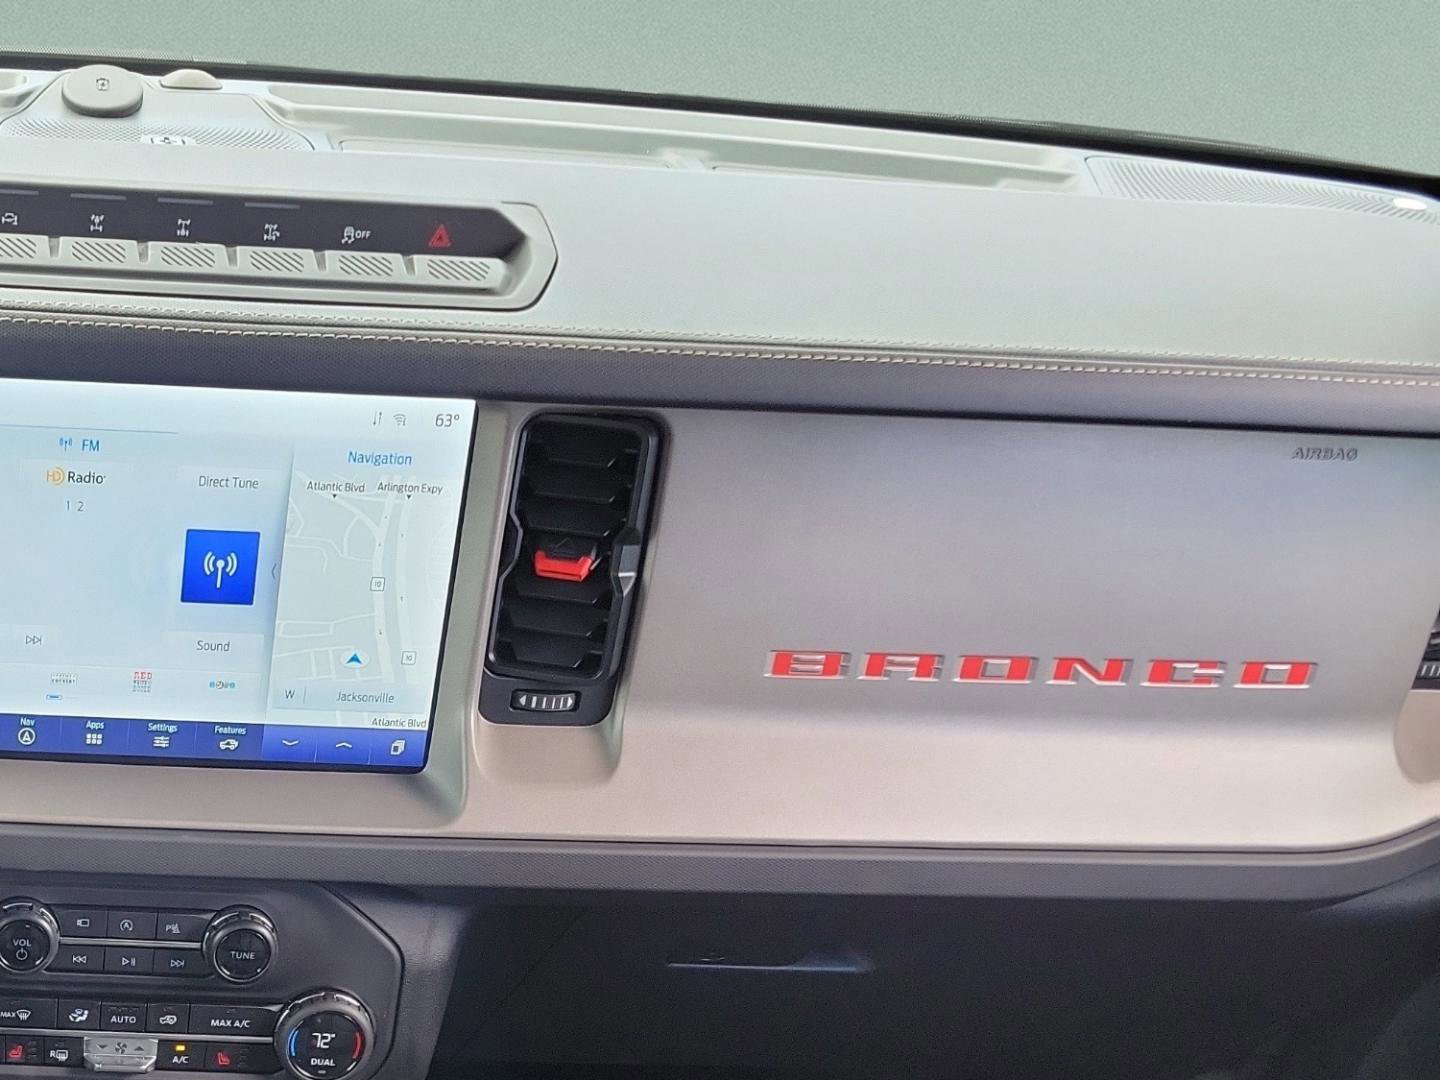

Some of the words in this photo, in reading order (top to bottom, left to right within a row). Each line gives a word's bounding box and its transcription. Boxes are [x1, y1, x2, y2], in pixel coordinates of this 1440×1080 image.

[355, 230, 371, 239] OFF
[435, 413, 460, 428] 63°
[81, 439, 100, 452] FM
[347, 450, 412, 466] Navigation
[1292, 446, 1358, 461] AIRBAG
[67, 470, 105, 485] Radio
[198, 475, 229, 489] Direct
[232, 477, 259, 490] Tune
[306, 480, 343, 493] Atlantic
[344, 482, 365, 493] Blvd
[377, 481, 420, 494] Arlington
[421, 484, 443, 495] Expy
[196, 640, 230, 652] Sound
[765, 649, 1318, 689] BRONCO
[284, 689, 295, 700] W
[336, 690, 395, 704] Jacksonville
[20, 717, 36, 727] Nav
[86, 720, 104, 731] Apps
[147, 722, 178, 734] Settings
[371, 716, 407, 729] Atlantic
[407, 718, 427, 729] Blvd
[214, 725, 246, 736] Features
[12, 938, 32, 948] VOL
[231, 951, 256, 960] TUNE
[0, 1010, 17, 1019] MAX
[110, 1015, 137, 1024] AUTO
[210, 1019, 232, 1028] MAX
[233, 1019, 251, 1029] A/C
[172, 1055, 189, 1064] A/C
[310, 1058, 336, 1067] DUAL
